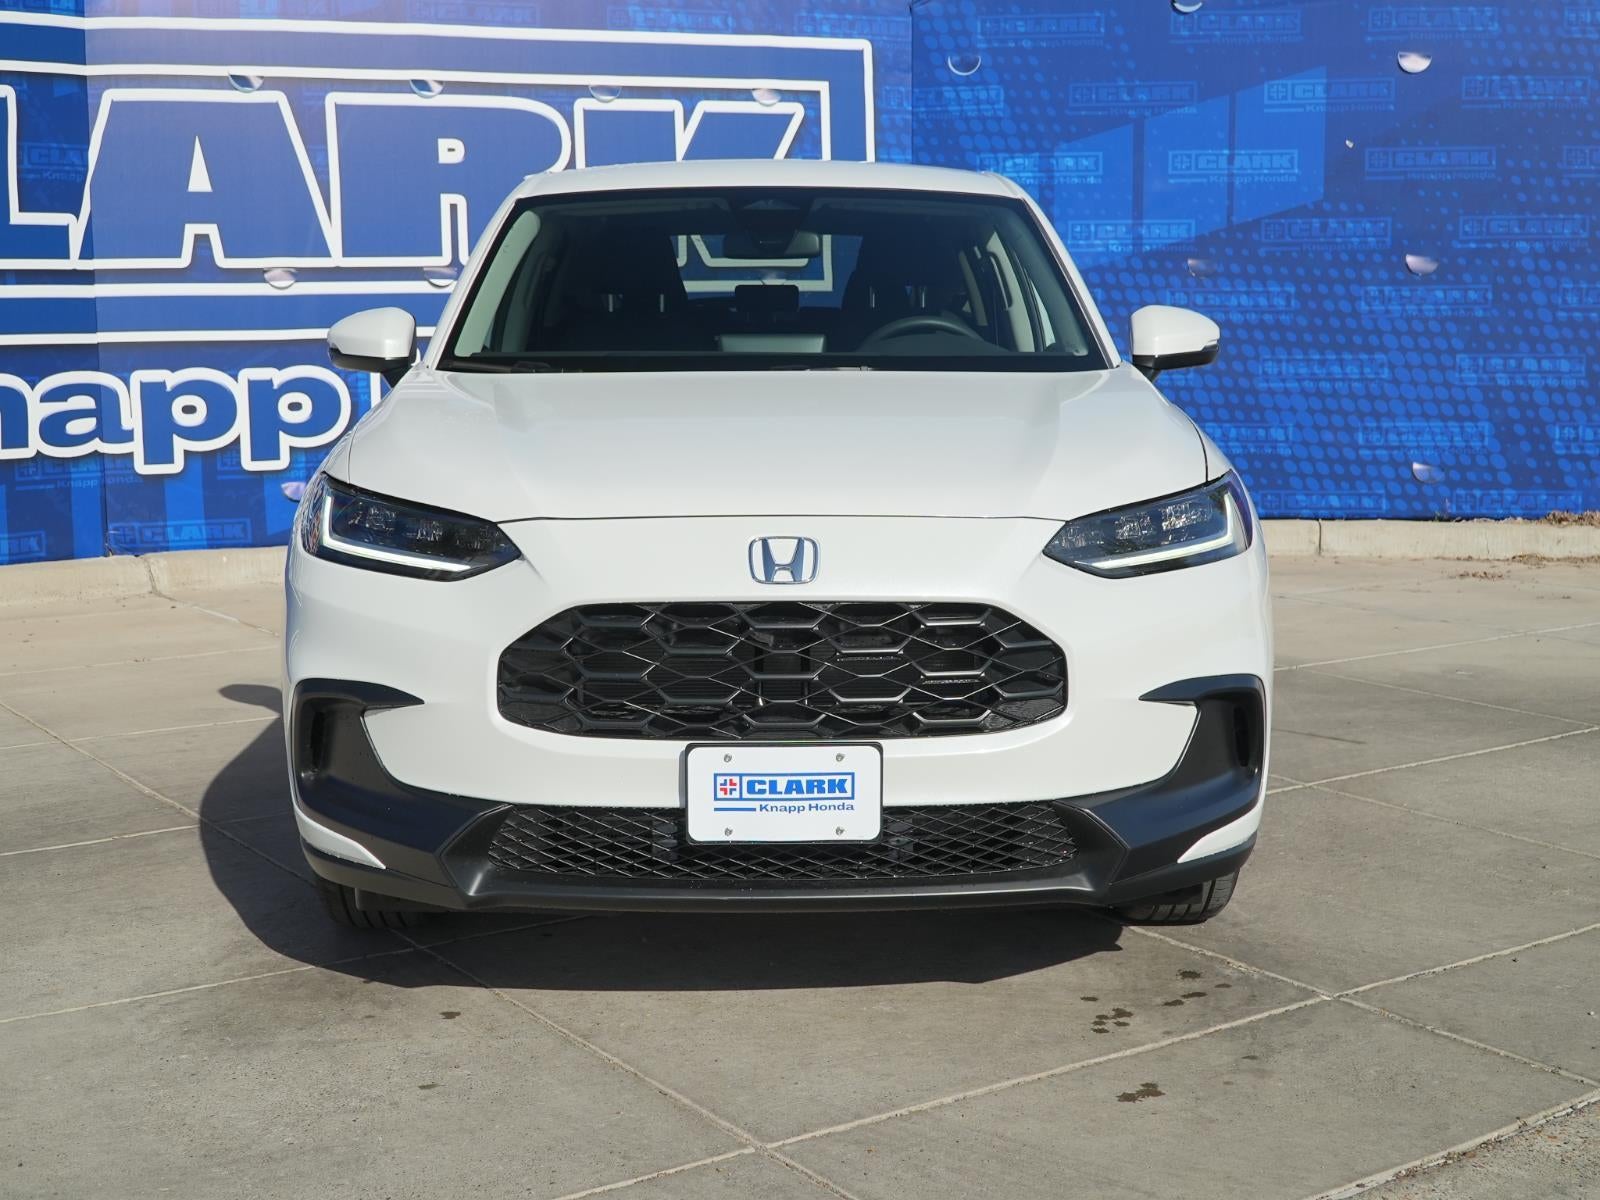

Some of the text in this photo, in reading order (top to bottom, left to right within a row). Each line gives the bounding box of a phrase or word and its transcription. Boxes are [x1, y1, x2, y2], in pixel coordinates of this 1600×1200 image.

[1198, 155, 1292, 169] CLARK
[1395, 151, 1490, 166] CLARK
[1209, 174, 1297, 185] Knapp Honda
[142, 522, 244, 543] CLARK
[746, 778, 848, 795] CLARK
[759, 802, 854, 814] Knapp Honda
